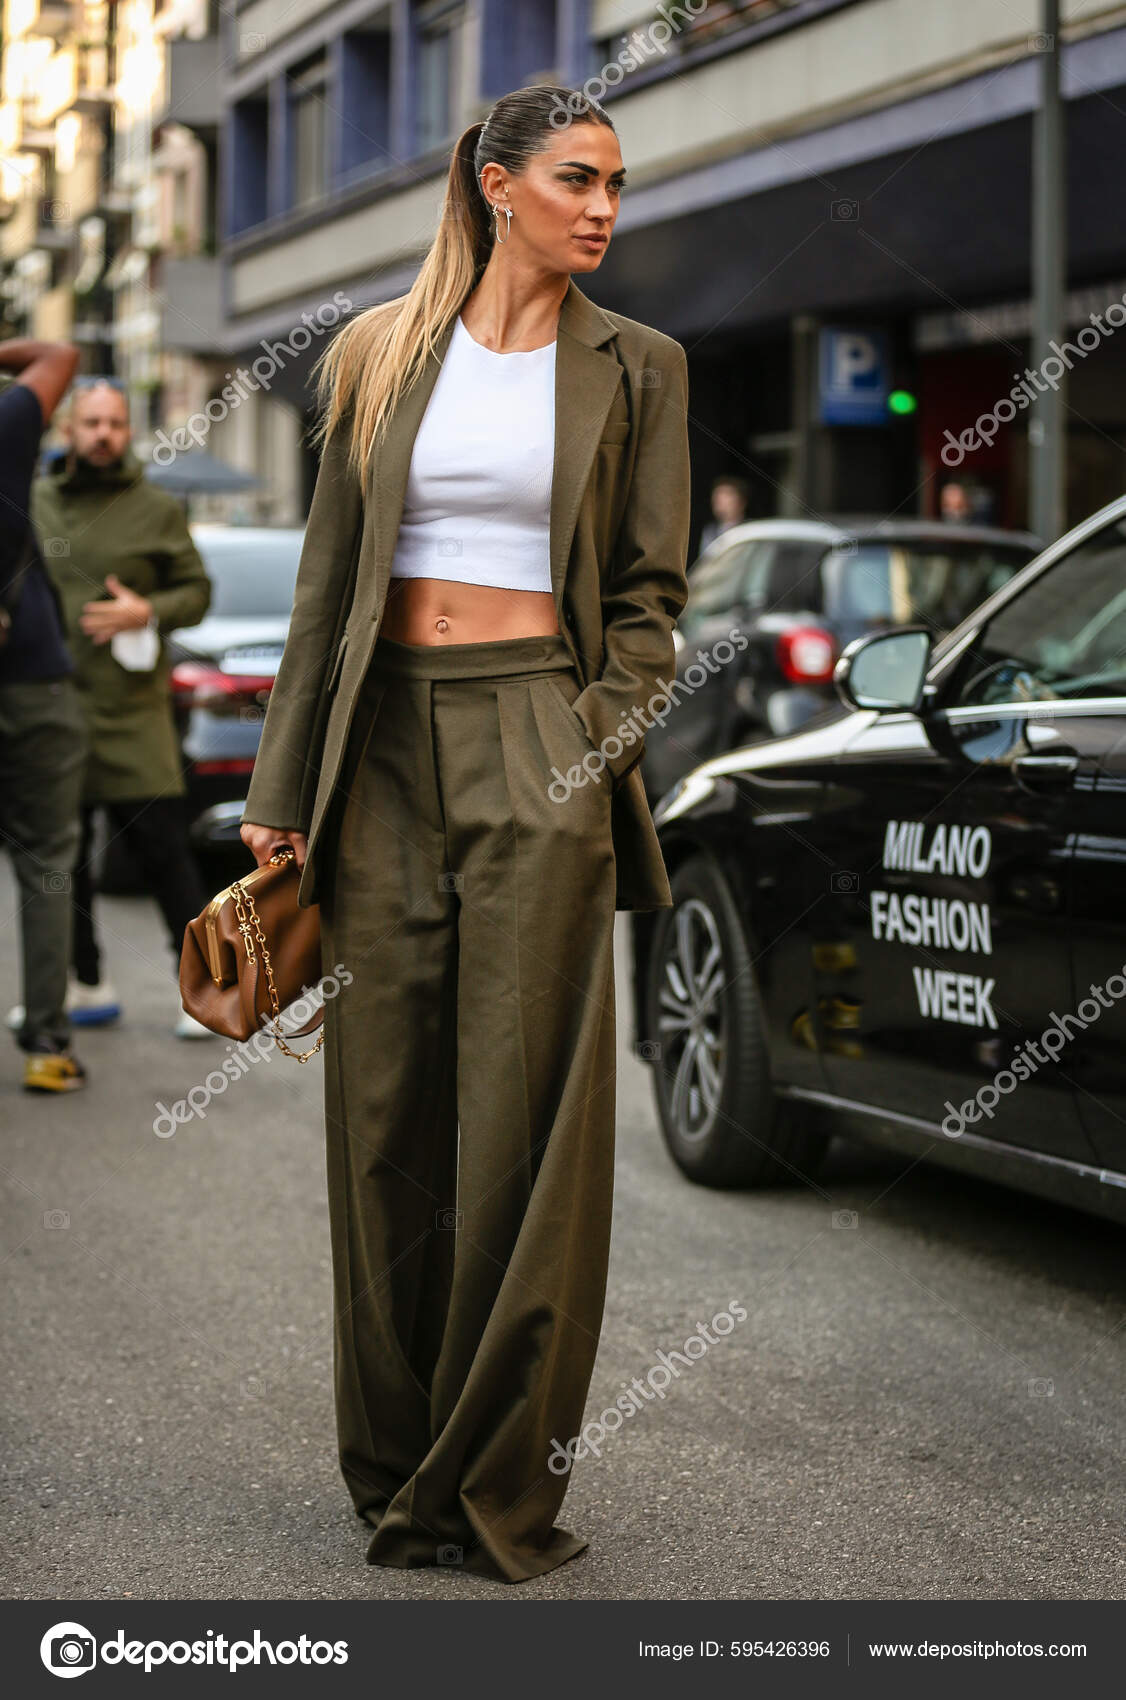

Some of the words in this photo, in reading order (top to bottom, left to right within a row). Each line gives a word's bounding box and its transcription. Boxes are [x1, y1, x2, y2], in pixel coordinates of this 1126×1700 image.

[833, 333, 876, 394] P
[882, 819, 992, 879] MILANO
[870, 890, 993, 955] FASHION
[912, 965, 999, 1030] WEEK
